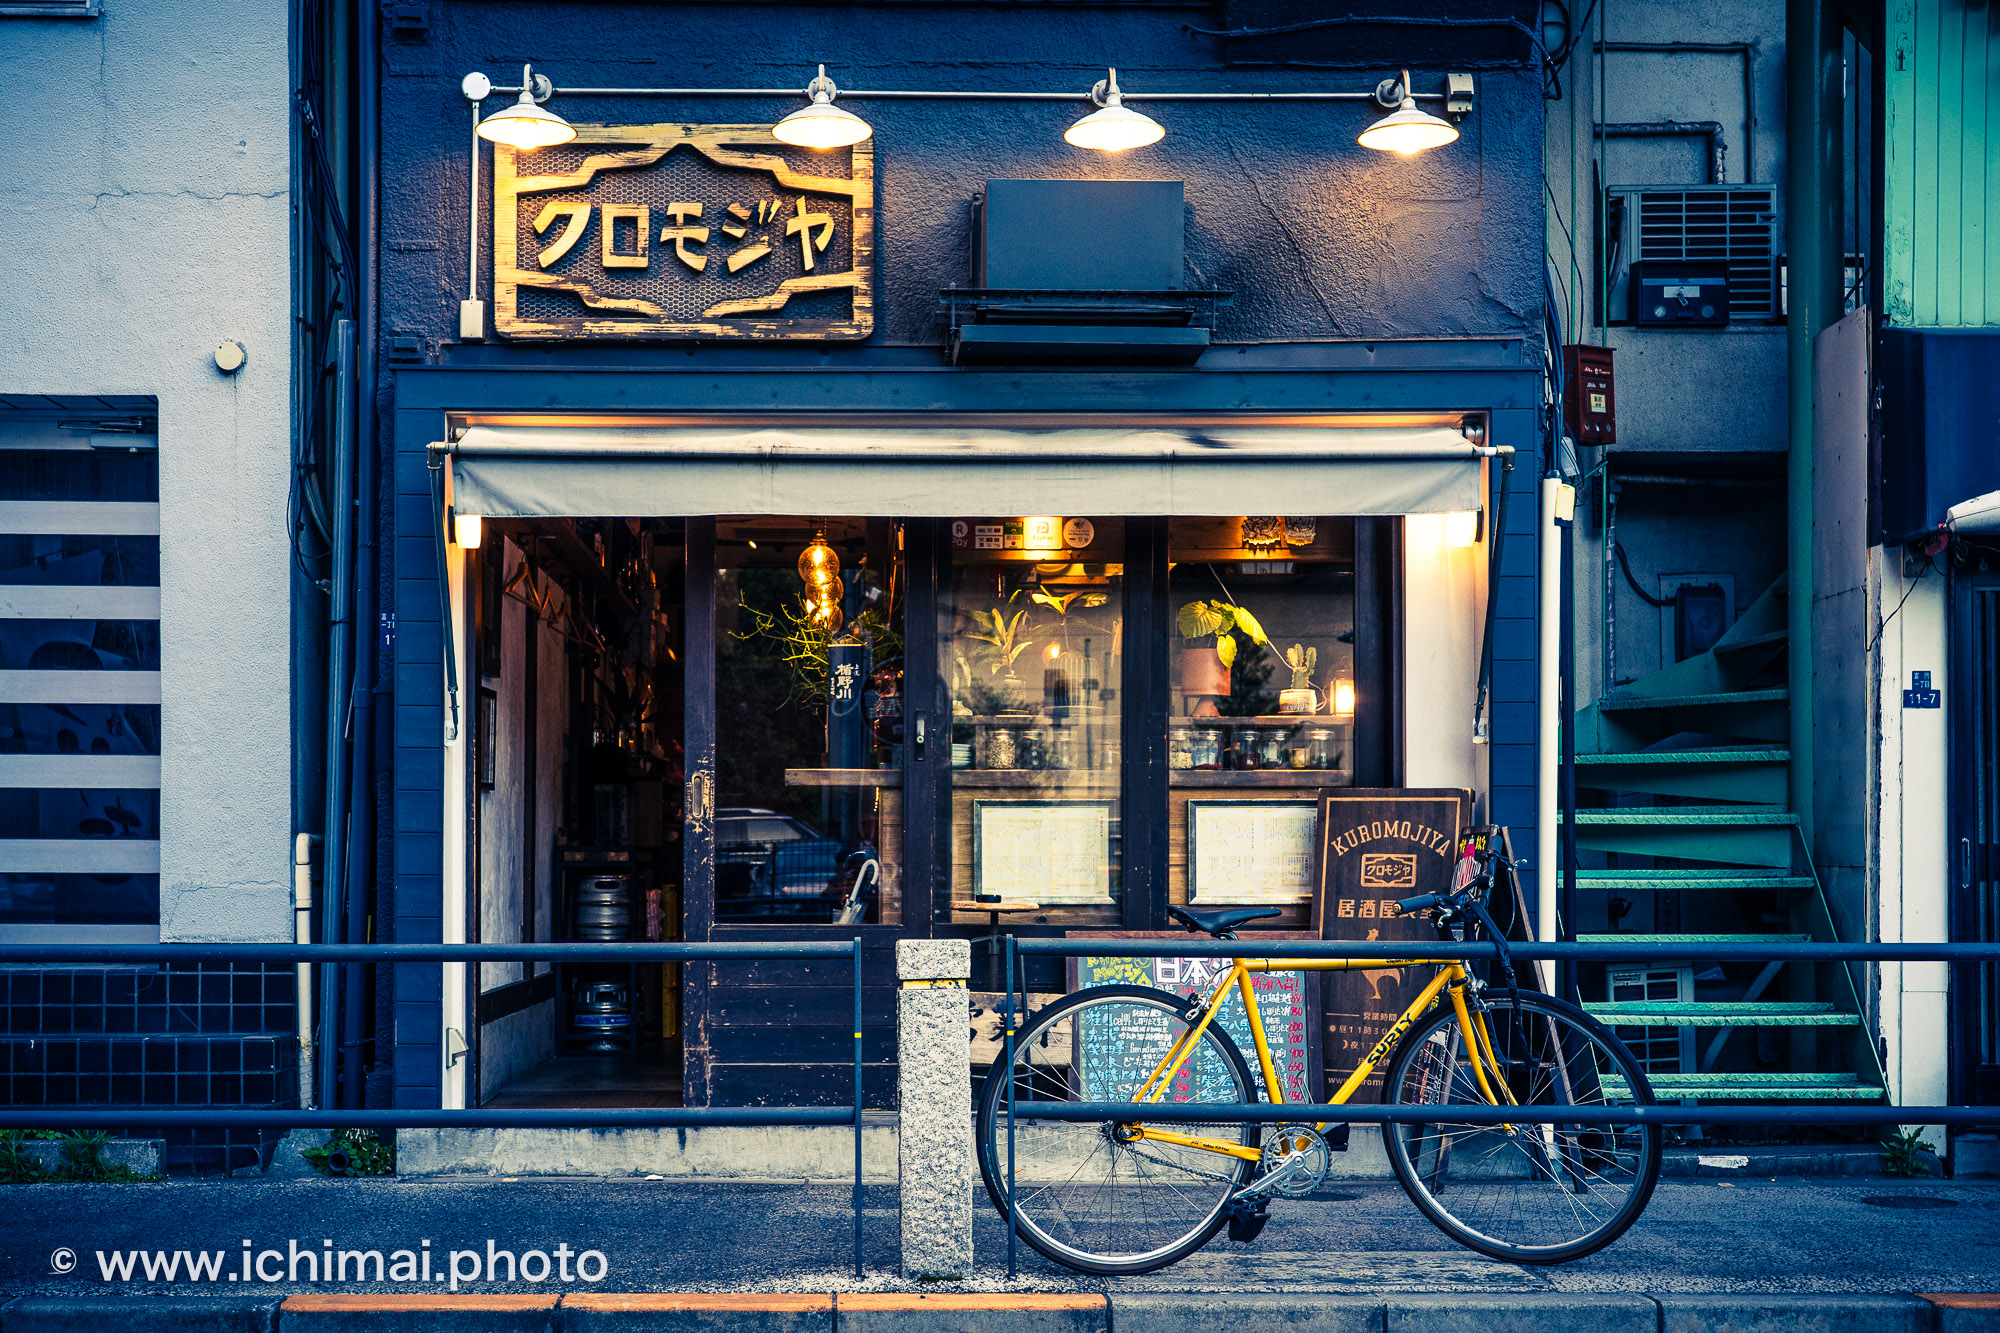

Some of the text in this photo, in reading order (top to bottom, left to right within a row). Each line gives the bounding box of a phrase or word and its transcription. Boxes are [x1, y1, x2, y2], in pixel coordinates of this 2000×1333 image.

[532, 195, 835, 274] クロモジヤ
[1909, 693, 1936, 704] 11-7
[1331, 820, 1451, 857] KUROMOJIYA
[1366, 864, 1411, 877] クロモジヤ
[1367, 1012, 1413, 1068] SURLY
